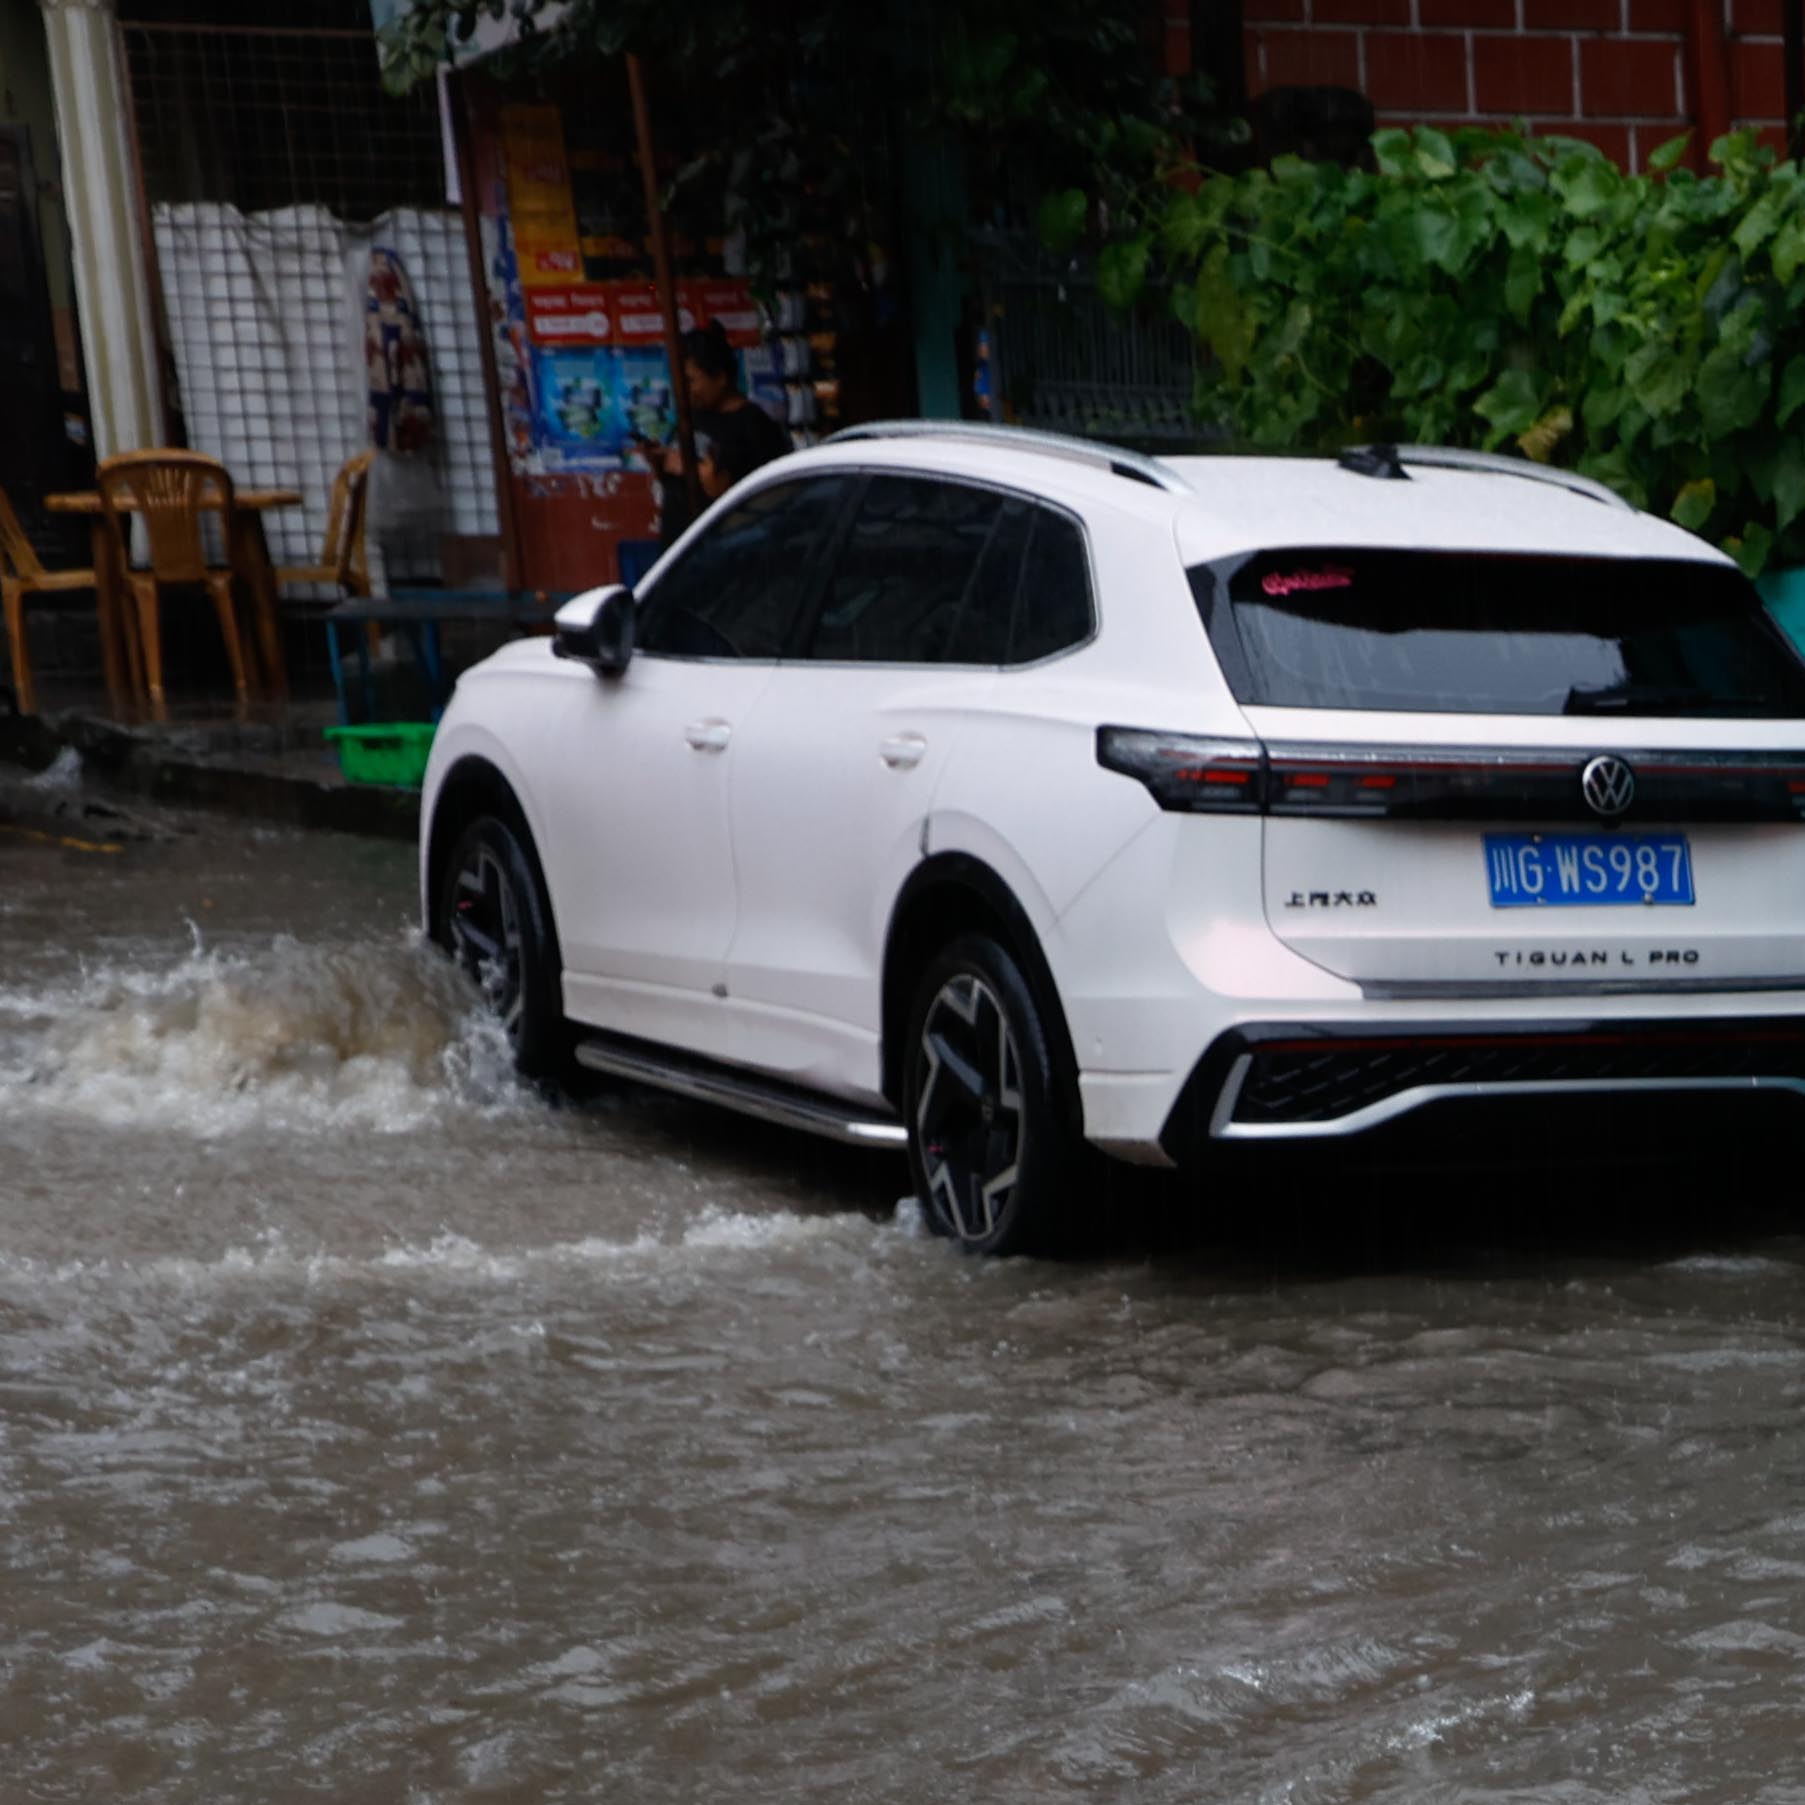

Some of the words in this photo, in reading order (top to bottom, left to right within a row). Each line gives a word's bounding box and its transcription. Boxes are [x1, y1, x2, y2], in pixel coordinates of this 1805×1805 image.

[1495, 951, 1607, 965] TIGUAN
[1621, 951, 1635, 965] L
[1650, 950, 1699, 965] PRO
